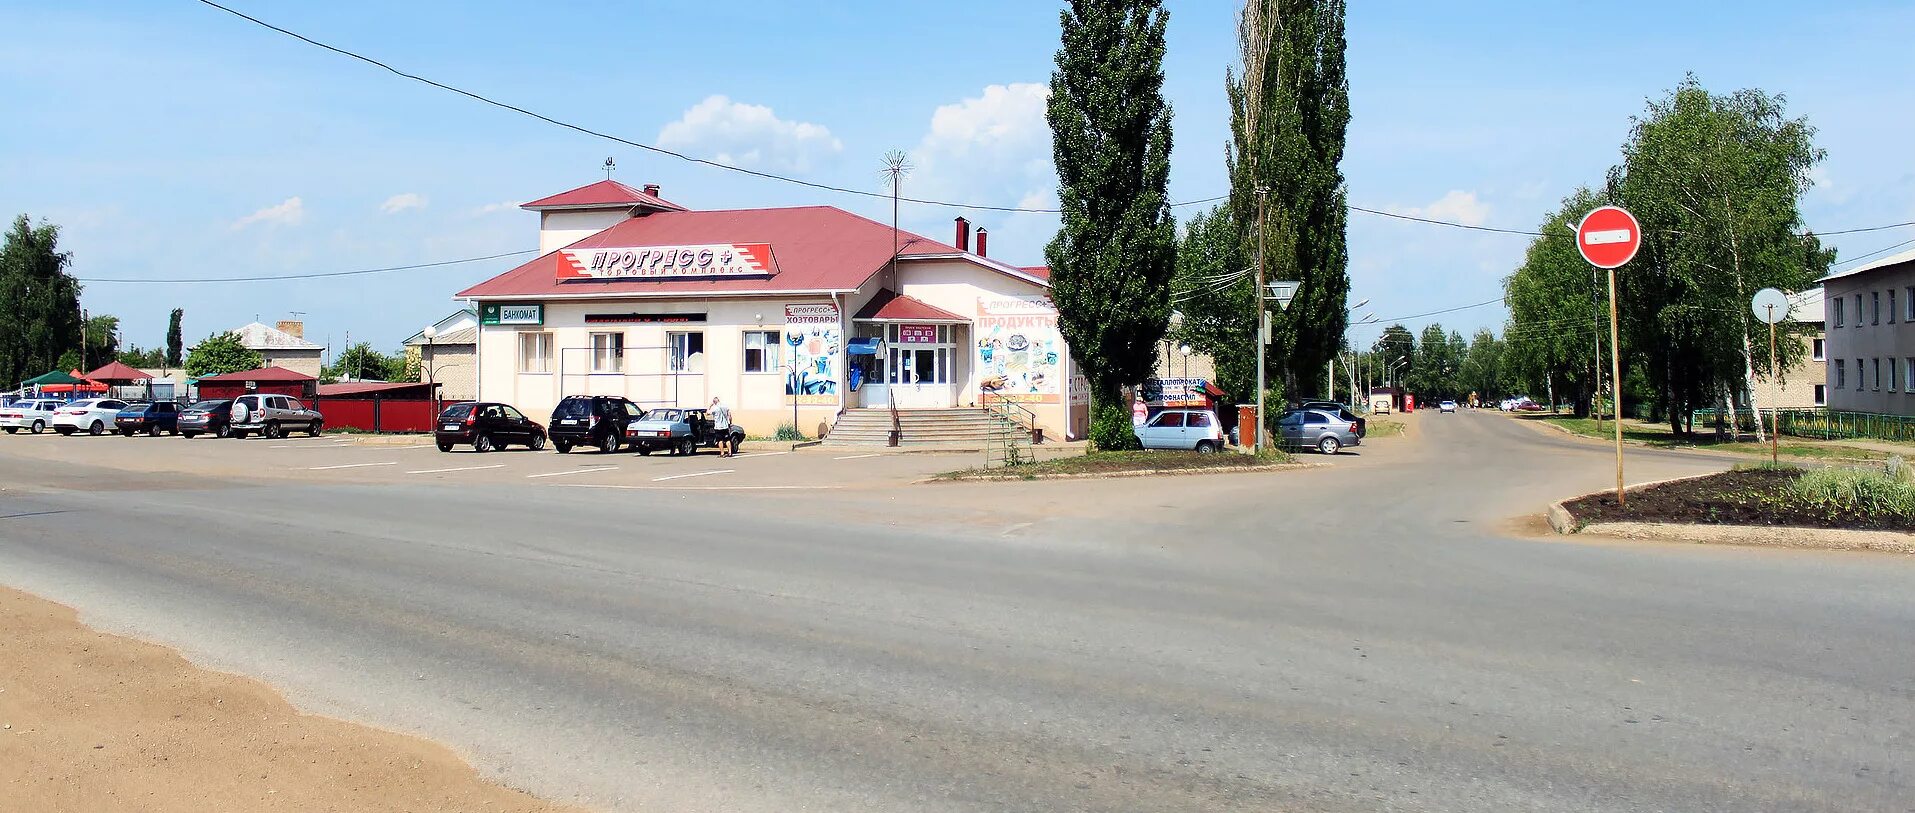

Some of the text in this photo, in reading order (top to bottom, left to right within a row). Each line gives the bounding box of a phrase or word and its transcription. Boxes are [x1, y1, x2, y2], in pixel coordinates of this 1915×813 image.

[591, 248, 714, 270] ПРОГРЕСС
[503, 309, 537, 320] БАНКОМАТ
[786, 316, 838, 324] ХОЗТОВАРЫ
[978, 316, 1058, 329] ПРОДУКТЫ
